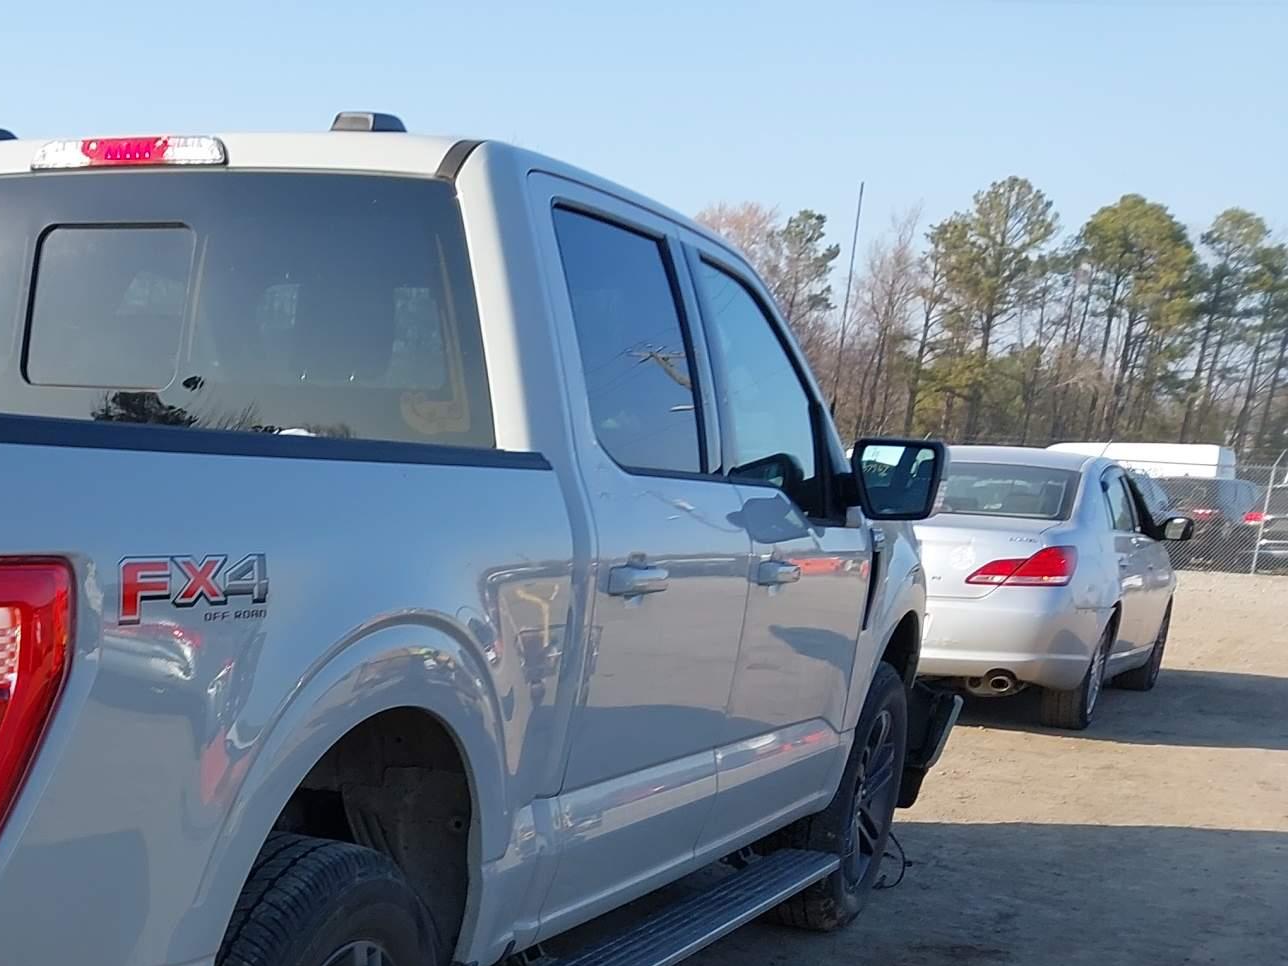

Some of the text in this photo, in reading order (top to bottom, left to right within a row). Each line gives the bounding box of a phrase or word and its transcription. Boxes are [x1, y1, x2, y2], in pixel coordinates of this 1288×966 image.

[118, 553, 269, 626] FX4
[204, 609, 267, 621] OFF ROAD
